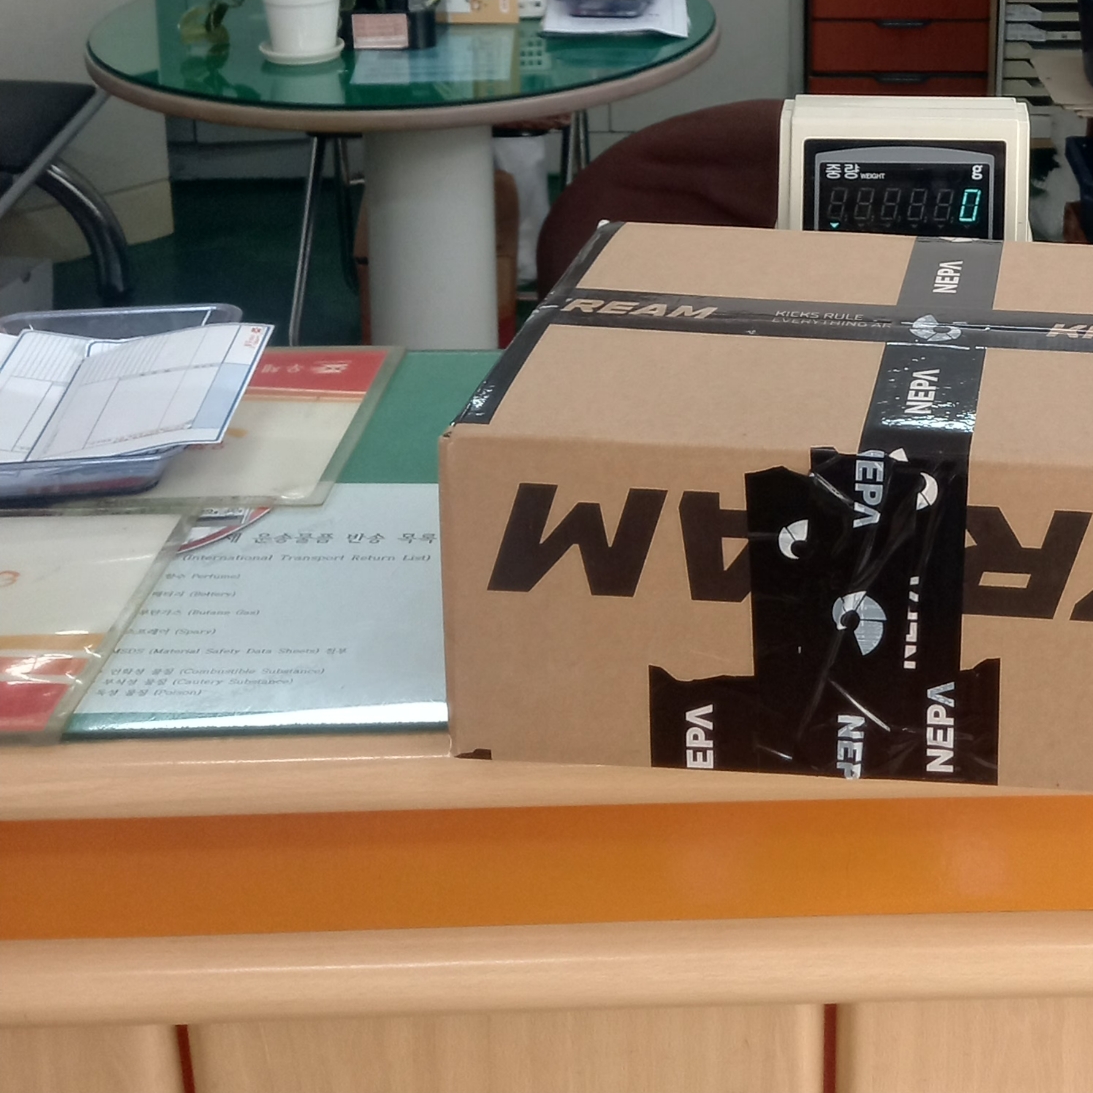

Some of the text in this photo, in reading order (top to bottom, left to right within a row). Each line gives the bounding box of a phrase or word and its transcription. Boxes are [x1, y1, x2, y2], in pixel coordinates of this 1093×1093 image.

[825, 163, 860, 179] 중량
[971, 165, 983, 180] g
[959, 189, 982, 222] 0
[932, 260, 964, 295] NEPA
[560, 298, 718, 319] REAM
[775, 311, 864, 321] KICKS RULE
[904, 368, 940, 414] NEPA
[926, 681, 955, 773] NEPA
